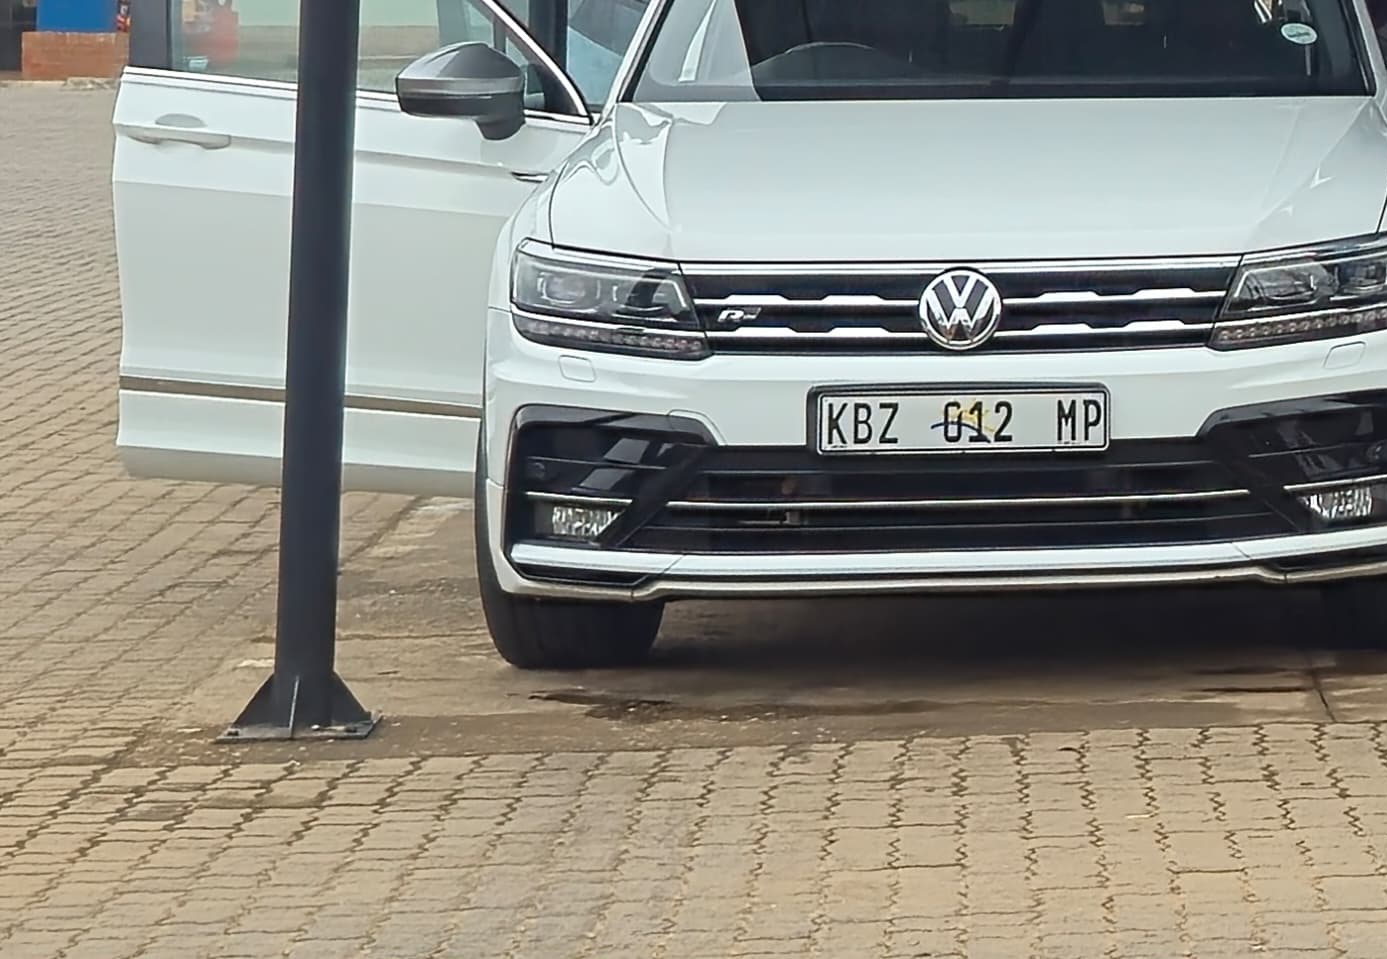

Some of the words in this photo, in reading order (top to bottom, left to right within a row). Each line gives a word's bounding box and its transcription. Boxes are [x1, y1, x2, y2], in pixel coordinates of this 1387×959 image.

[826, 402, 899, 445] KBZ
[942, 400, 1014, 443] 012
[1056, 398, 1102, 444] MP
